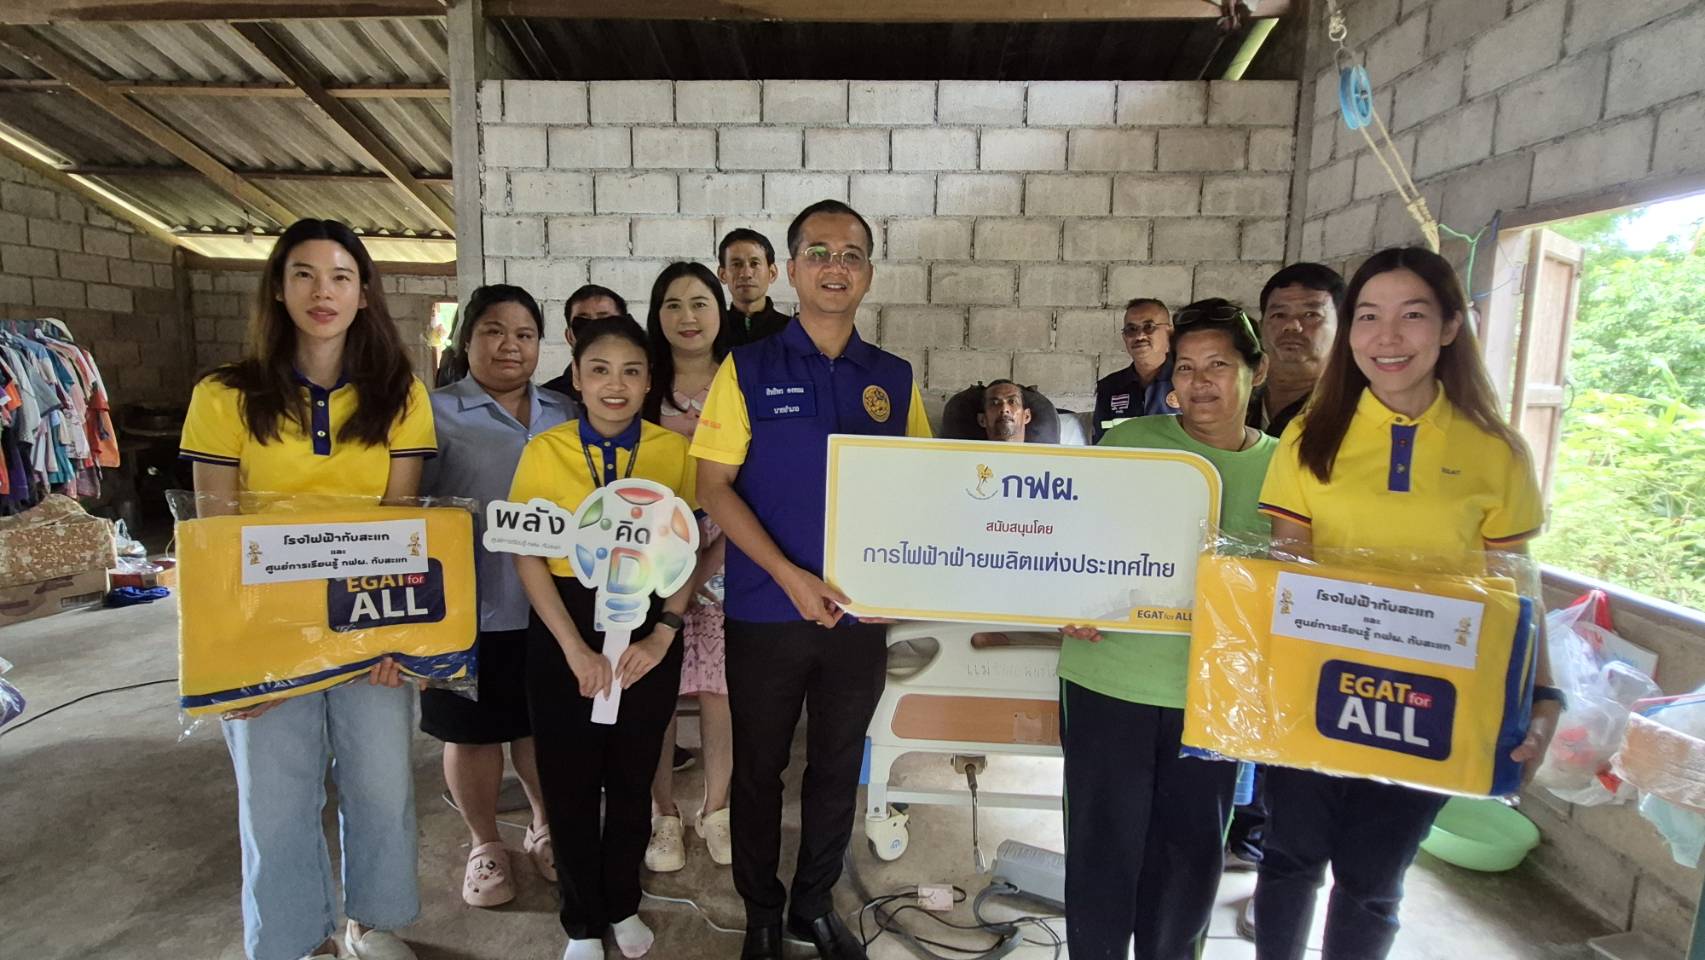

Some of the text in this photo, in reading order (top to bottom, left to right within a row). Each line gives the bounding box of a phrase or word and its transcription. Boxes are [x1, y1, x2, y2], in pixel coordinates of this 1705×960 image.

[1001, 471, 1079, 501] กฟผ.
[283, 531, 391, 546] โรงไฟฟ้าทับสะแก
[496, 506, 651, 545] พลัง คิด
[985, 519, 1054, 537] สนับสนุนโดย
[265, 557, 339, 575] ศูนย์การเรียนรู้
[407, 574, 425, 586] for
[349, 586, 429, 623] ALL
[1136, 609, 1164, 621] EGAT
[1315, 588, 1436, 619] โรงไฟฟ้าทับสะแก
[1338, 672, 1432, 708] EGAT for
[1337, 695, 1431, 748] ALL
